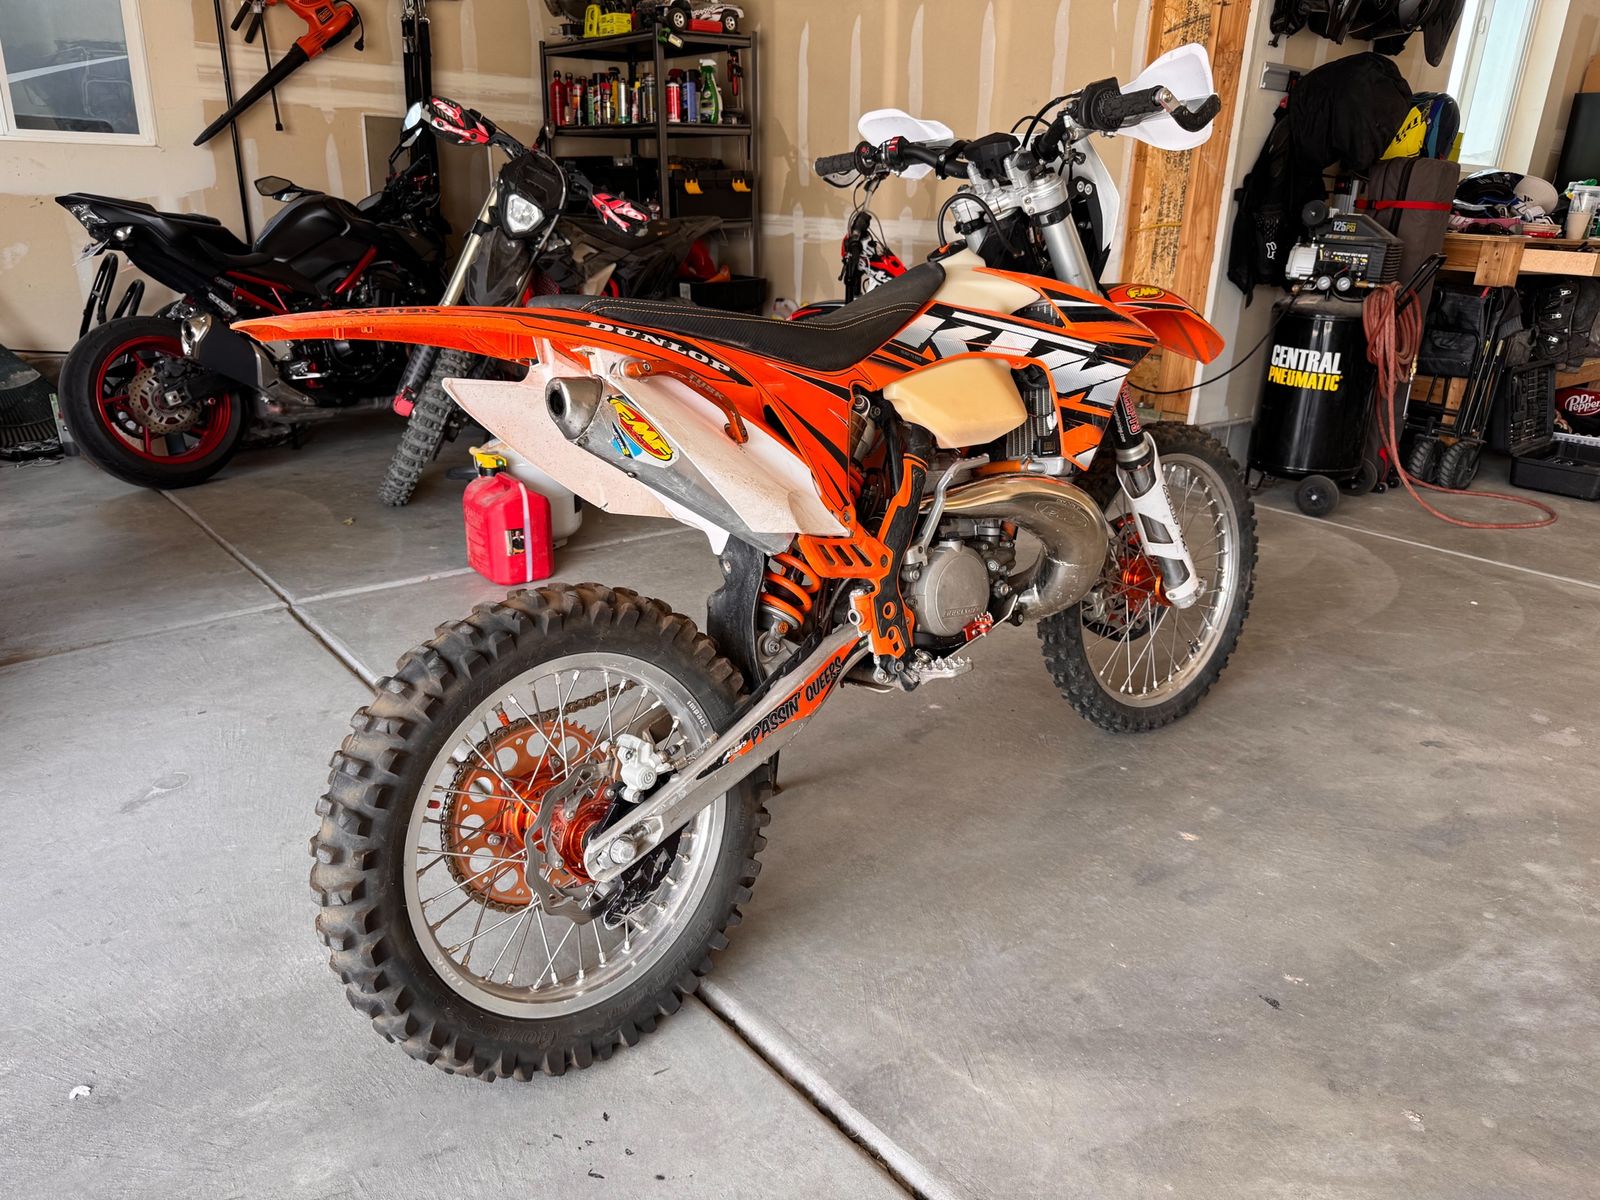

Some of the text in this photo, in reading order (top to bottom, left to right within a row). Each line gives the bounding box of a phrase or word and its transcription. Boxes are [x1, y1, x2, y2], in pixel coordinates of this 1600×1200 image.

[1128, 287, 1161, 299] FMF
[586, 321, 731, 373] DUNLOP
[893, 312, 1132, 406] KTM
[1271, 344, 1342, 375] CENTRAL
[1267, 365, 1341, 392] PNEUMATIC
[1568, 395, 1600, 413] Pepper
[1579, 394, 1595, 404] Dr
[609, 398, 675, 457] FMF
[750, 656, 842, 745] PASSIN' QUEERS
